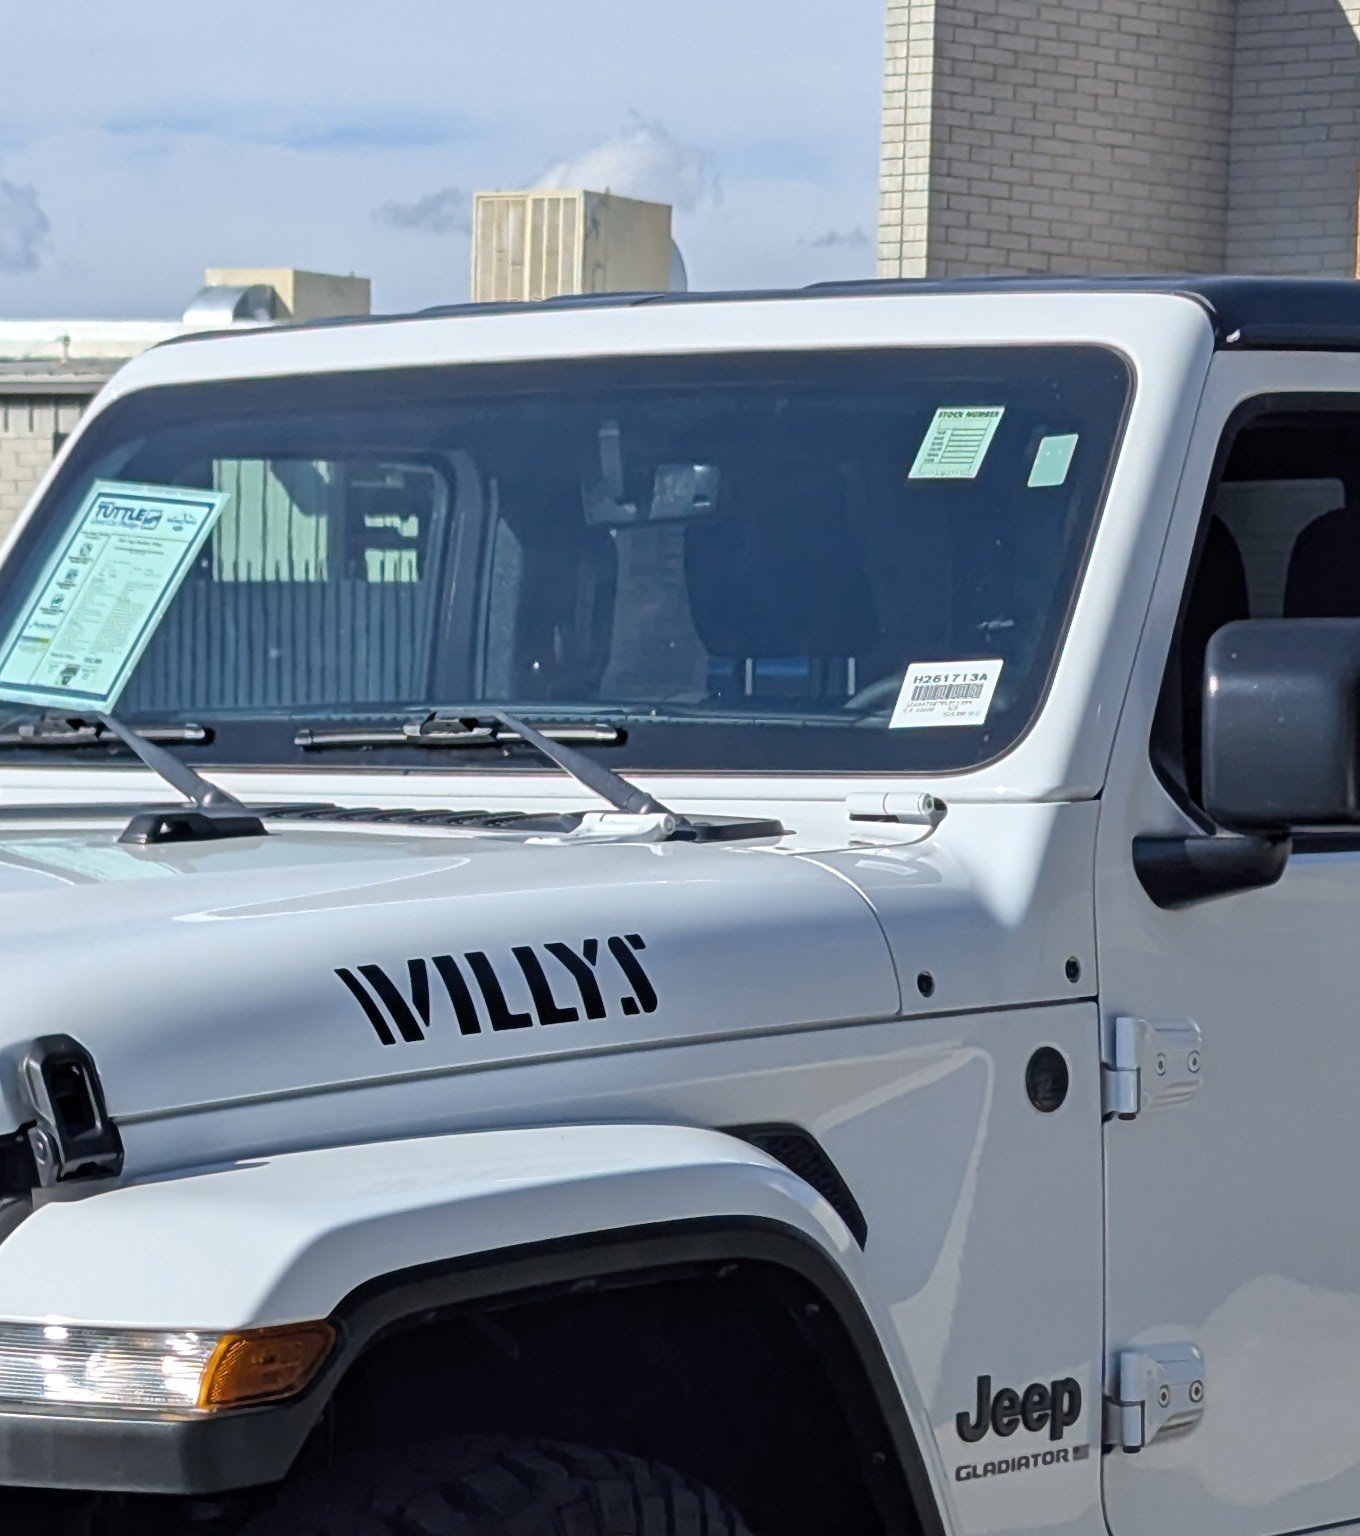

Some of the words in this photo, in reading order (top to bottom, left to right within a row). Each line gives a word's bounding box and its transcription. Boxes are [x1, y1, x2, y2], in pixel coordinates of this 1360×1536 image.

[95, 504, 147, 521] TUTTLE
[913, 673, 988, 684] H261713A
[333, 933, 658, 1046] WILLYS
[955, 1374, 1082, 1443] Jeep
[955, 1448, 1070, 1482] GLADIATOR
